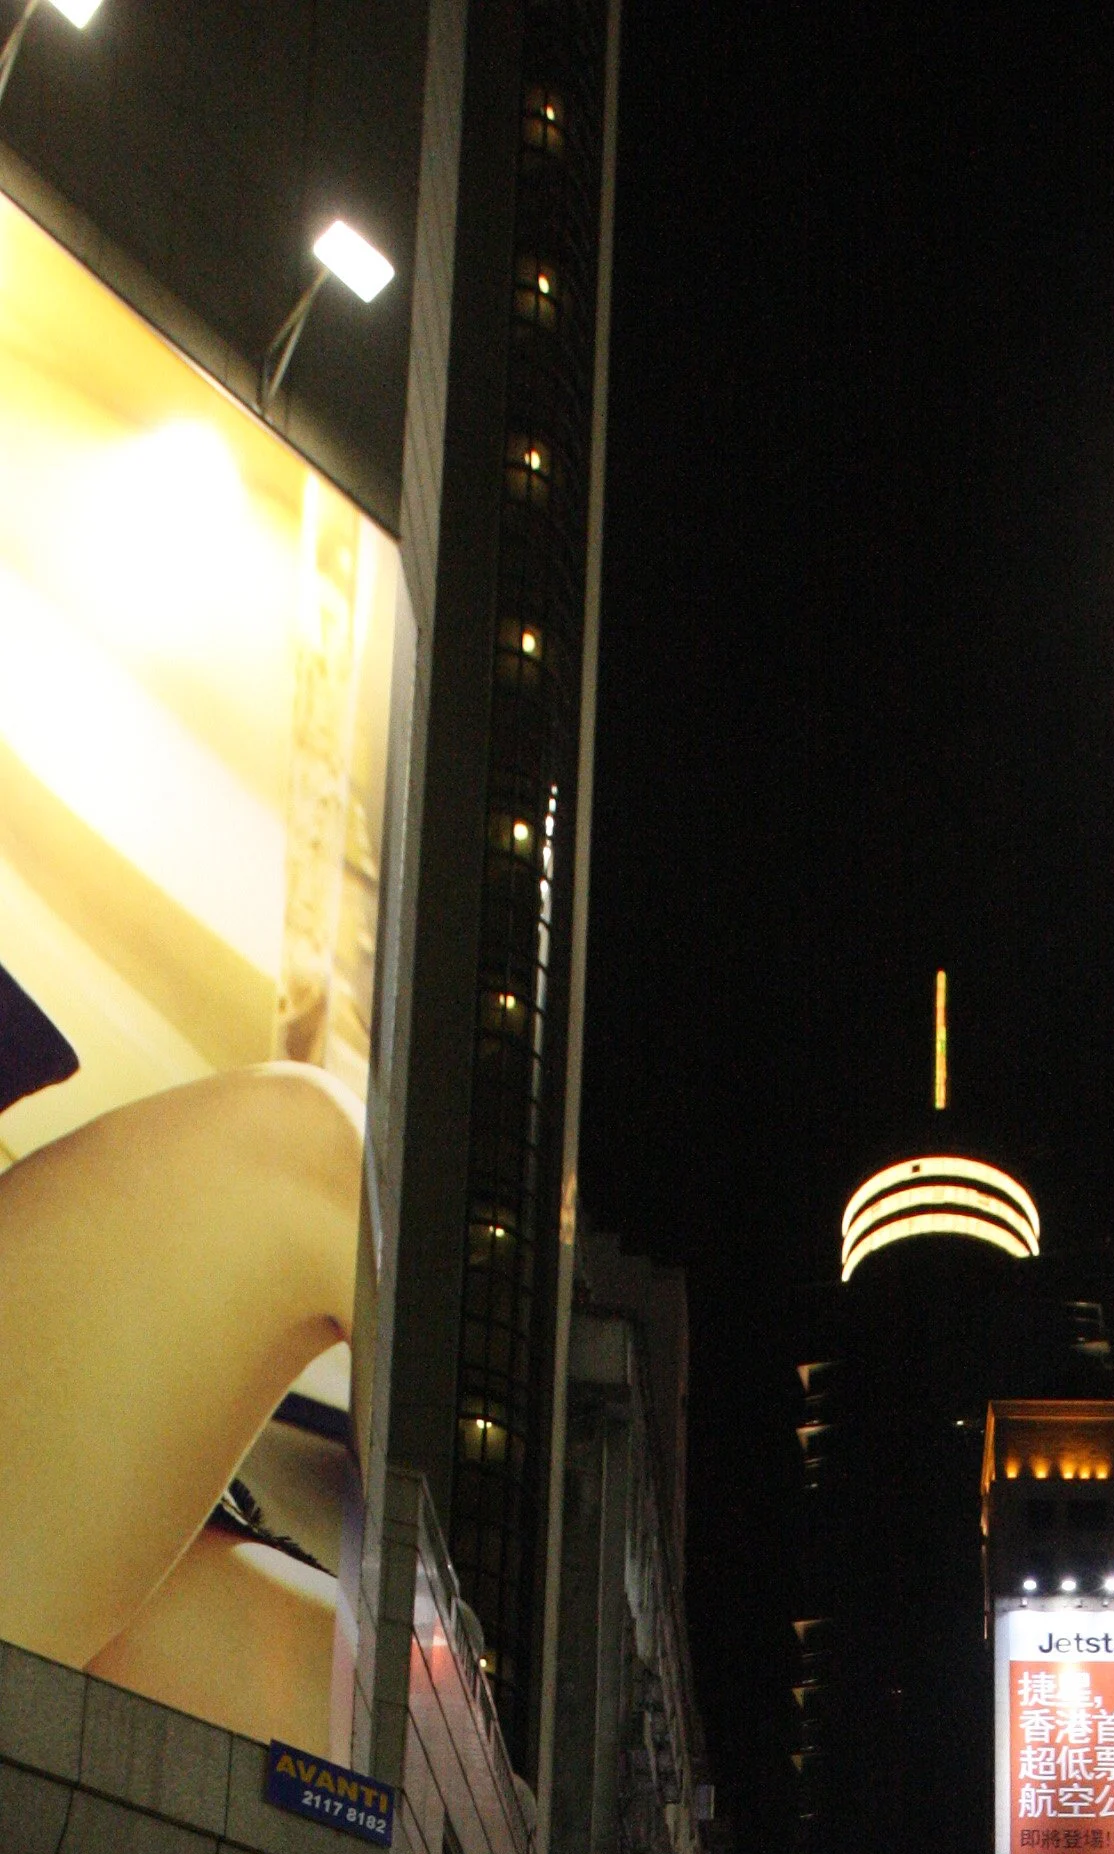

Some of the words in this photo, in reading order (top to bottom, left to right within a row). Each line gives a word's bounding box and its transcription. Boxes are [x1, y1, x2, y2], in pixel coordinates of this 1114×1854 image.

[276, 1753, 389, 1814] AVANTI
[301, 1790, 343, 1817] 2117
[346, 1807, 387, 1834] 8182
